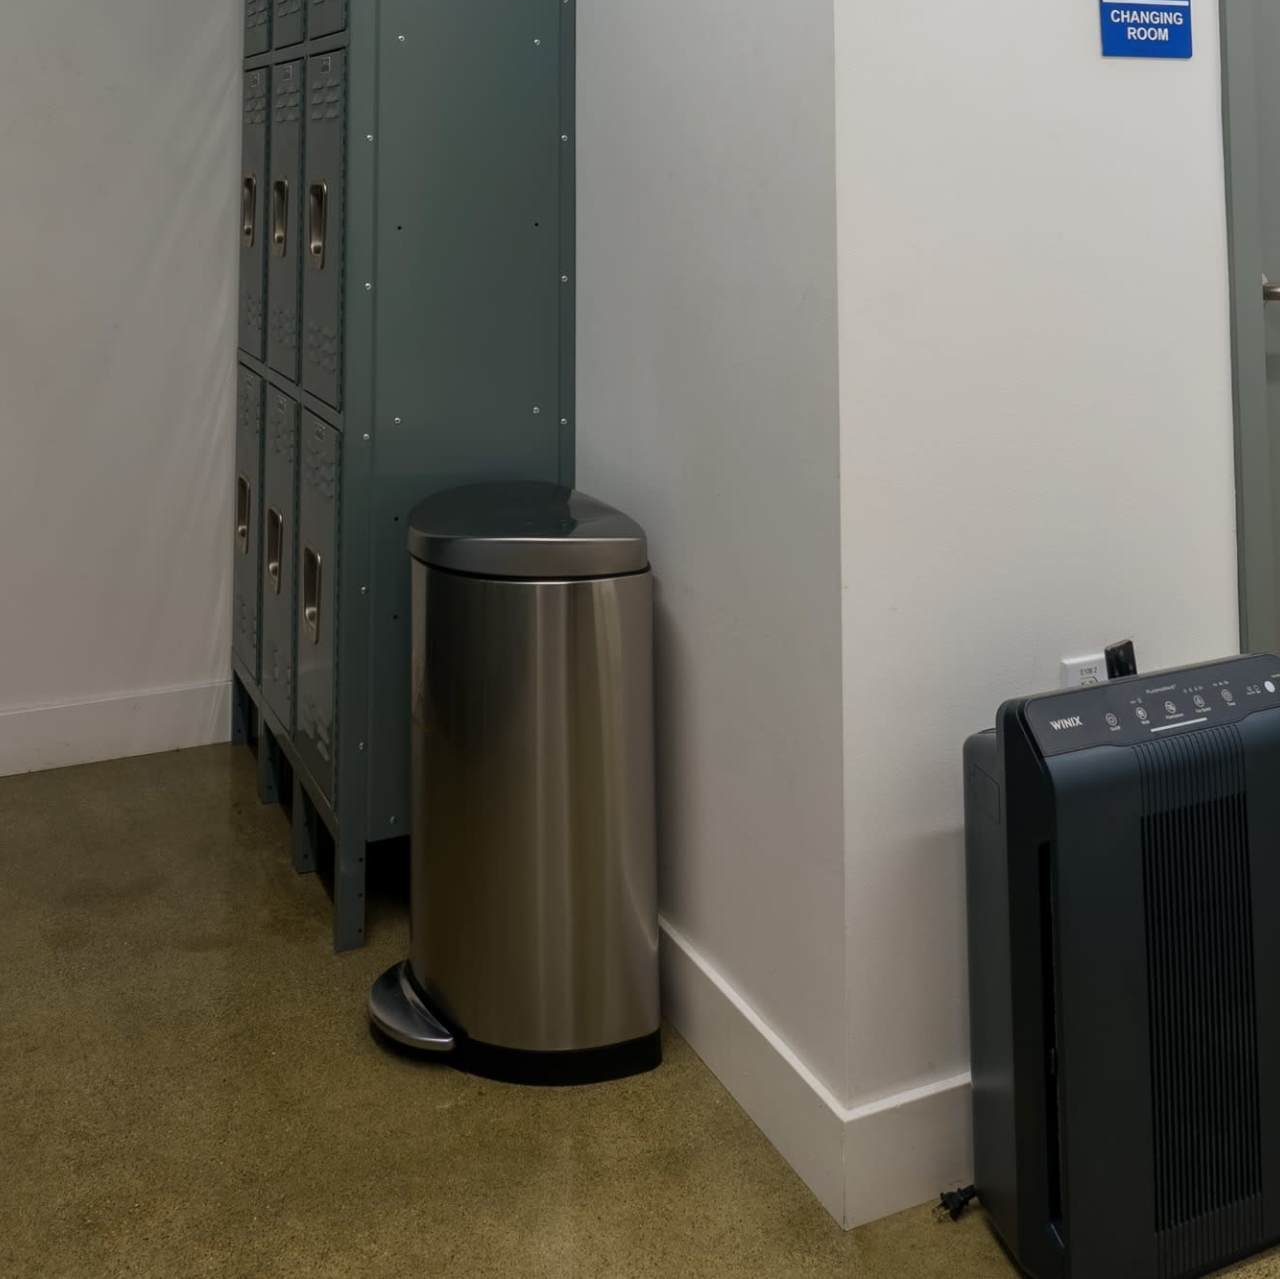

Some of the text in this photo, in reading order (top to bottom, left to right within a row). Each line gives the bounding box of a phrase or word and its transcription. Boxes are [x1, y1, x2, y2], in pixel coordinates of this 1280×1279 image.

[1110, 9, 1184, 25] CHANGING
[1127, 26, 1169, 41] ROOM
[1049, 715, 1083, 731] WINIX
